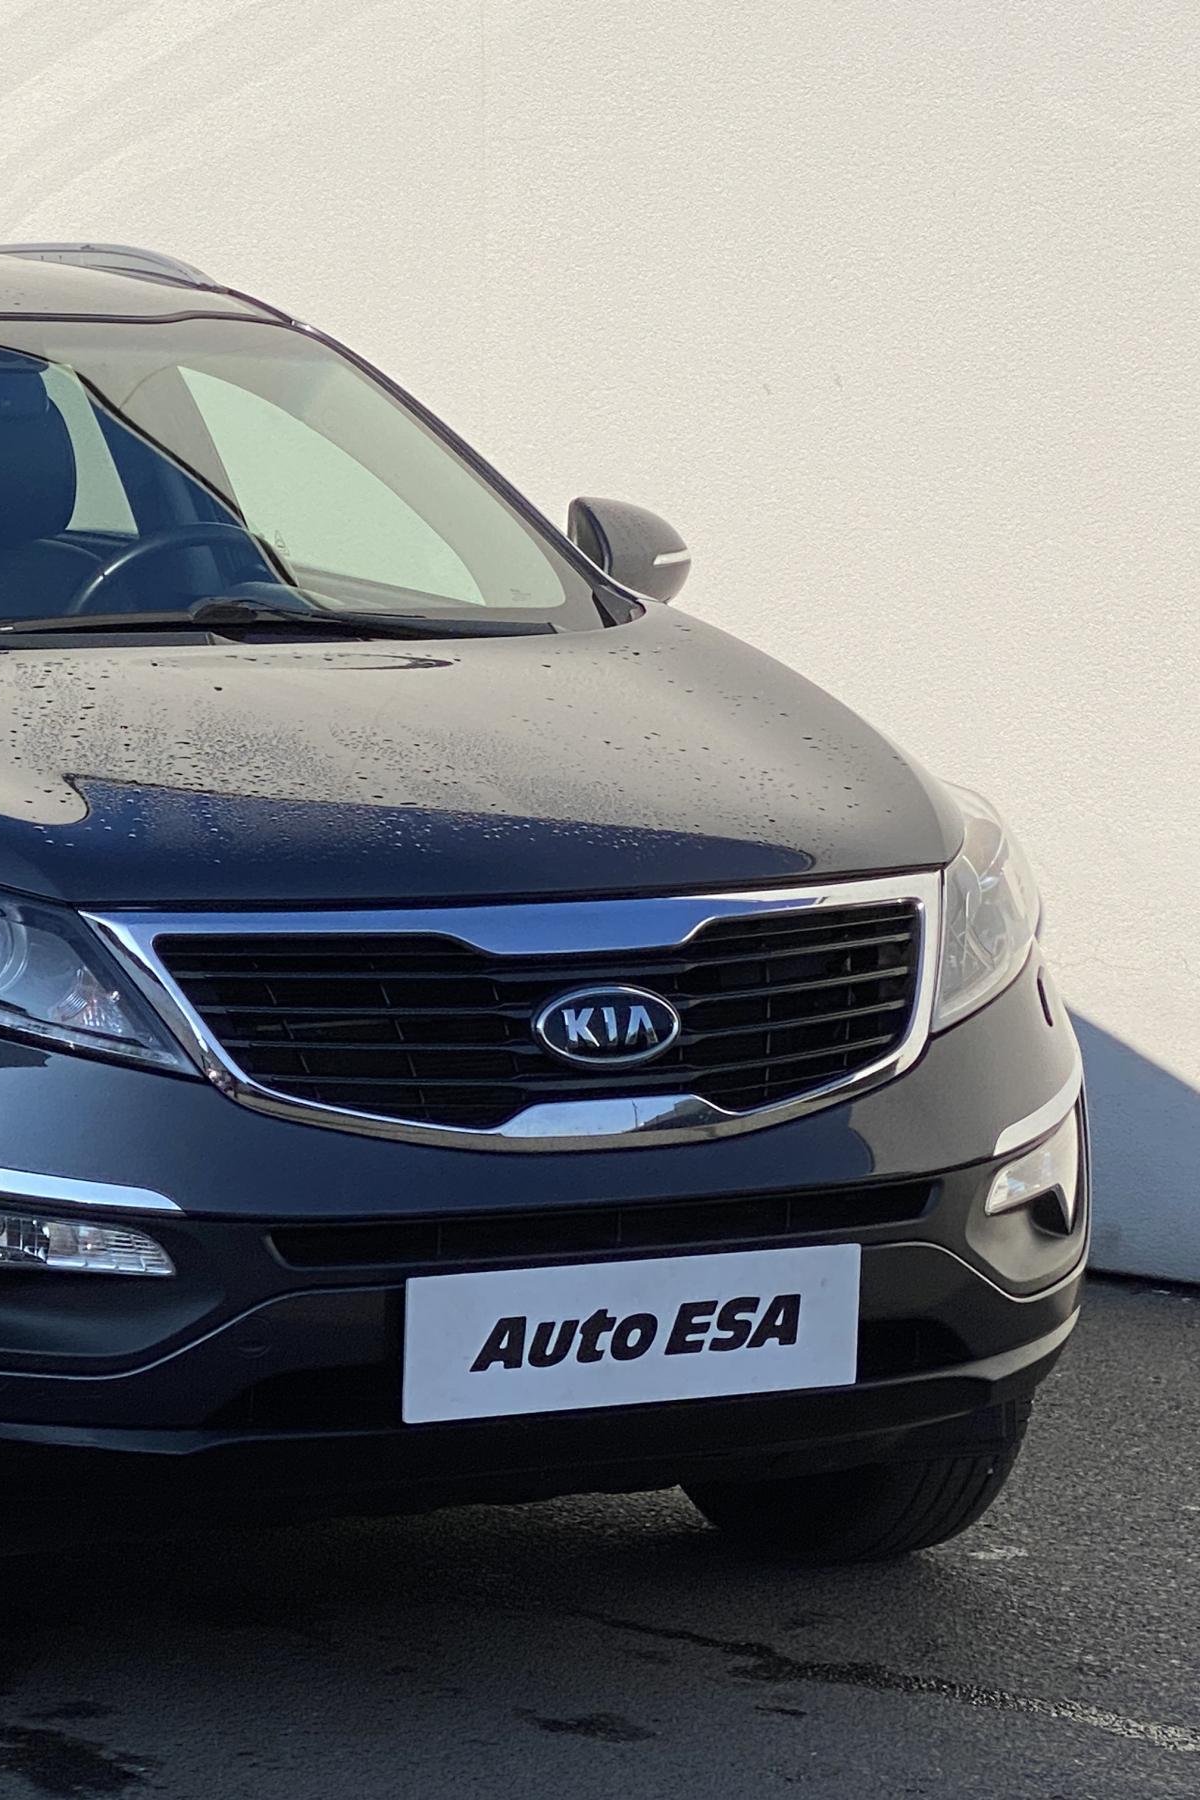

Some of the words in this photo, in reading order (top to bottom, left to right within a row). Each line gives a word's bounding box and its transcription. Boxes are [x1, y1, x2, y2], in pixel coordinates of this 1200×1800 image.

[561, 1005, 659, 1048] KIA
[469, 1308, 658, 1373] Auto
[664, 1293, 801, 1356] ESA
